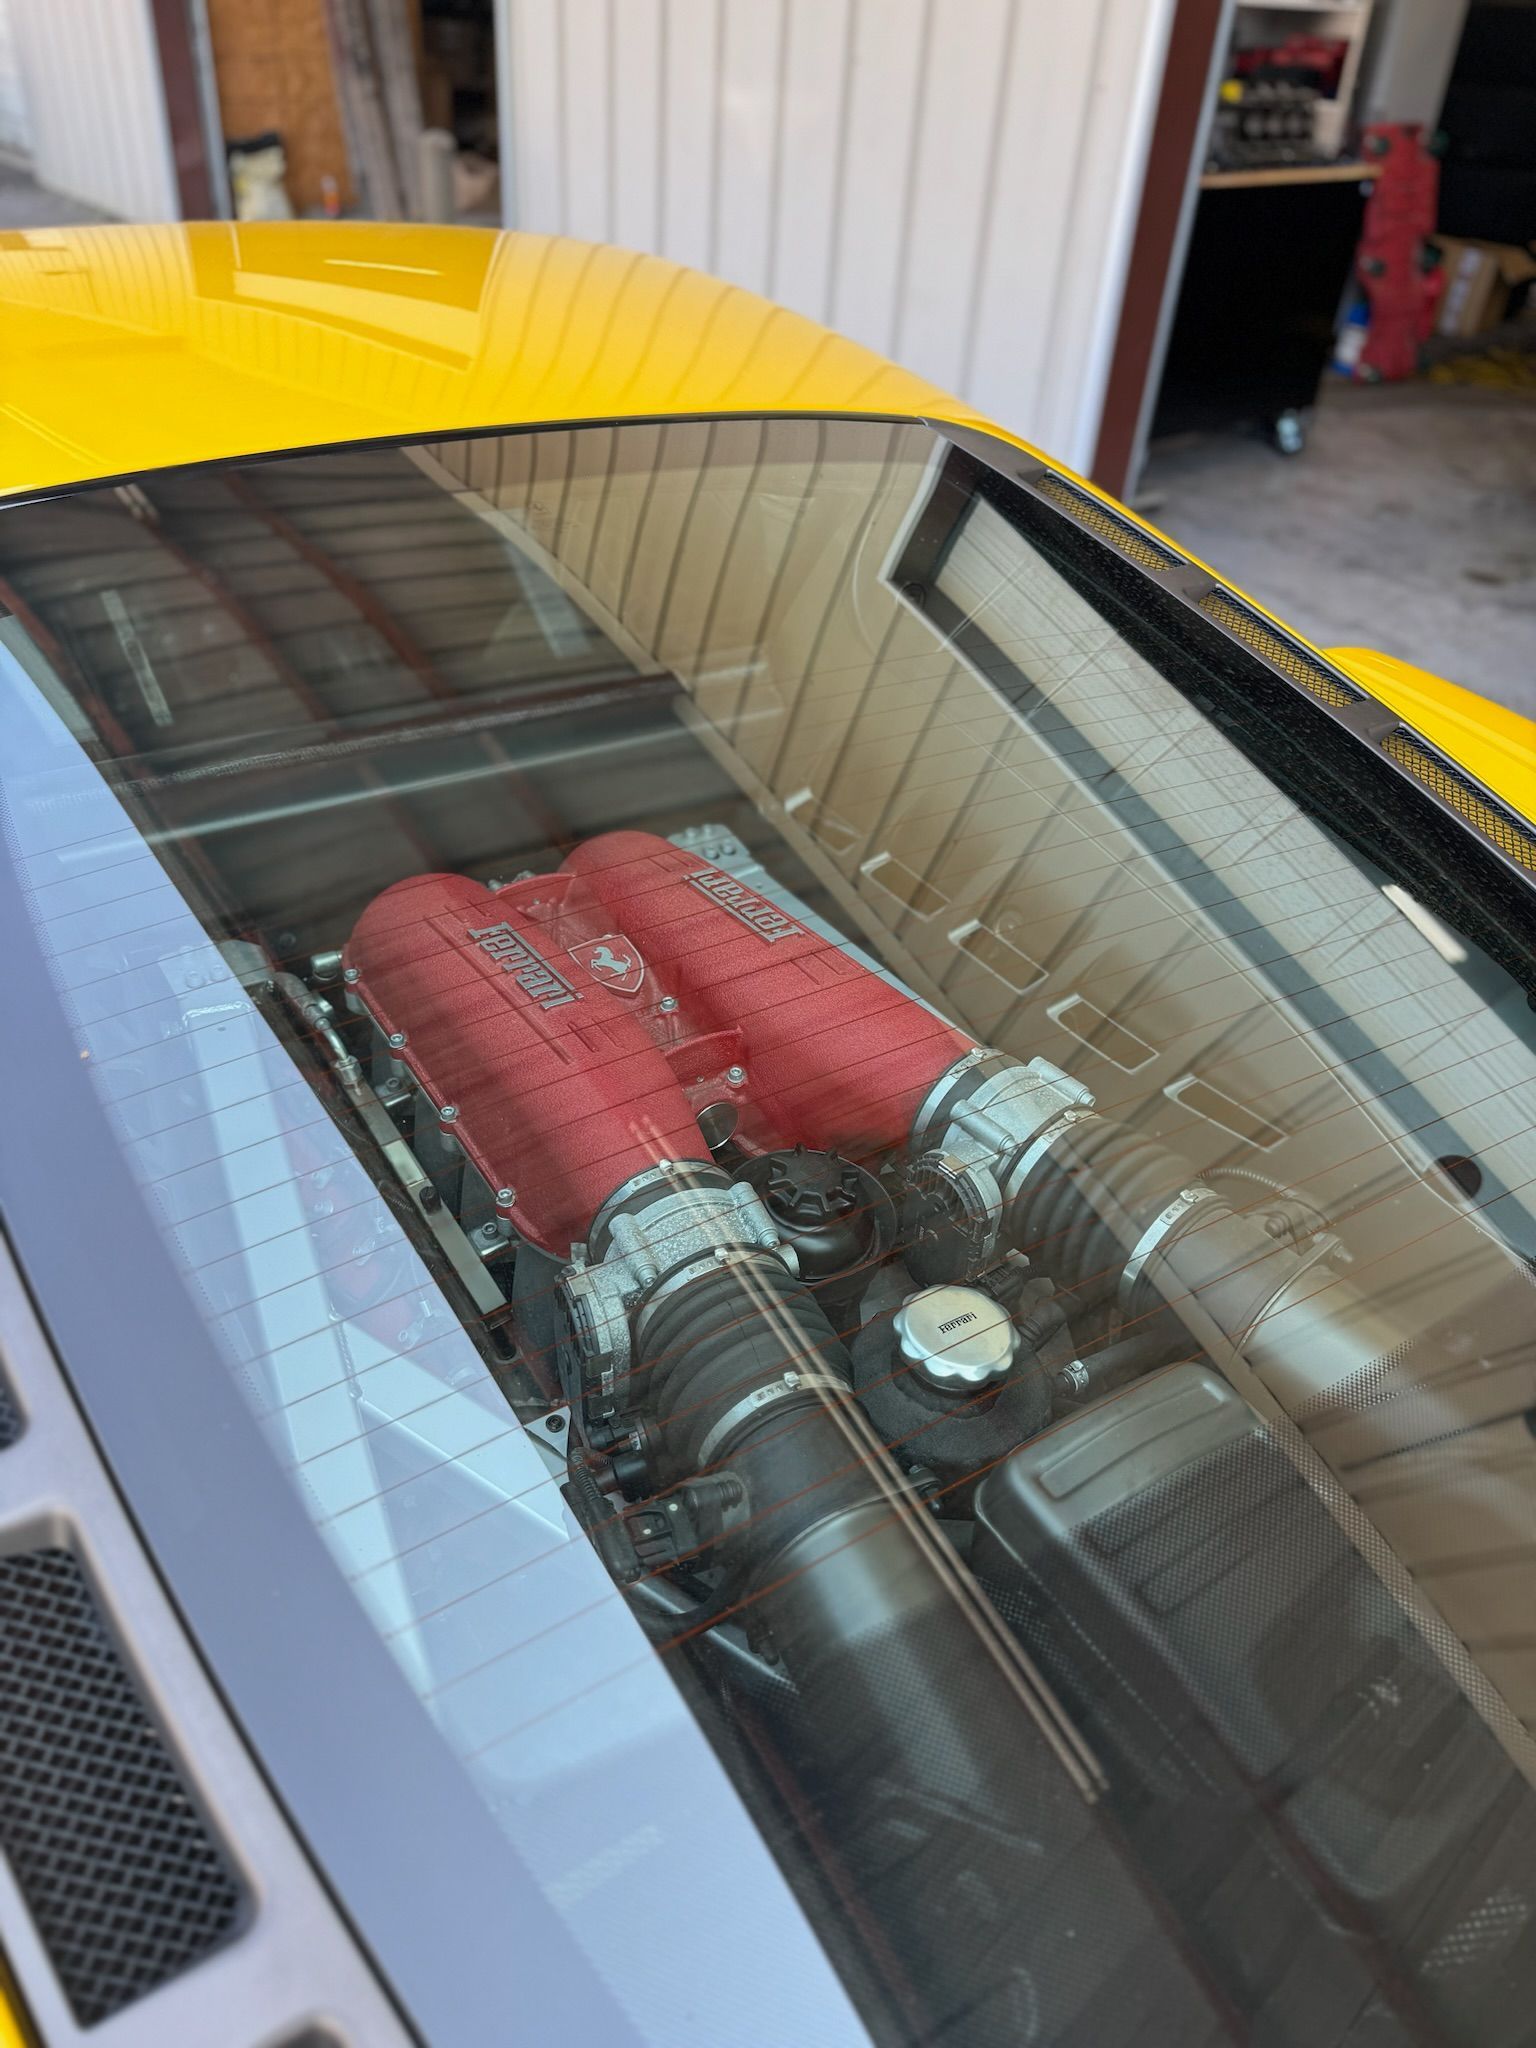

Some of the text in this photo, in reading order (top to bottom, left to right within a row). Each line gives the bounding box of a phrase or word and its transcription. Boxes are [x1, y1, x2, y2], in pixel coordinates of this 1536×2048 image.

[683, 867, 802, 943] Ferrari
[467, 921, 584, 1010] Ferrari
[938, 1312, 978, 1334] Ferrari
